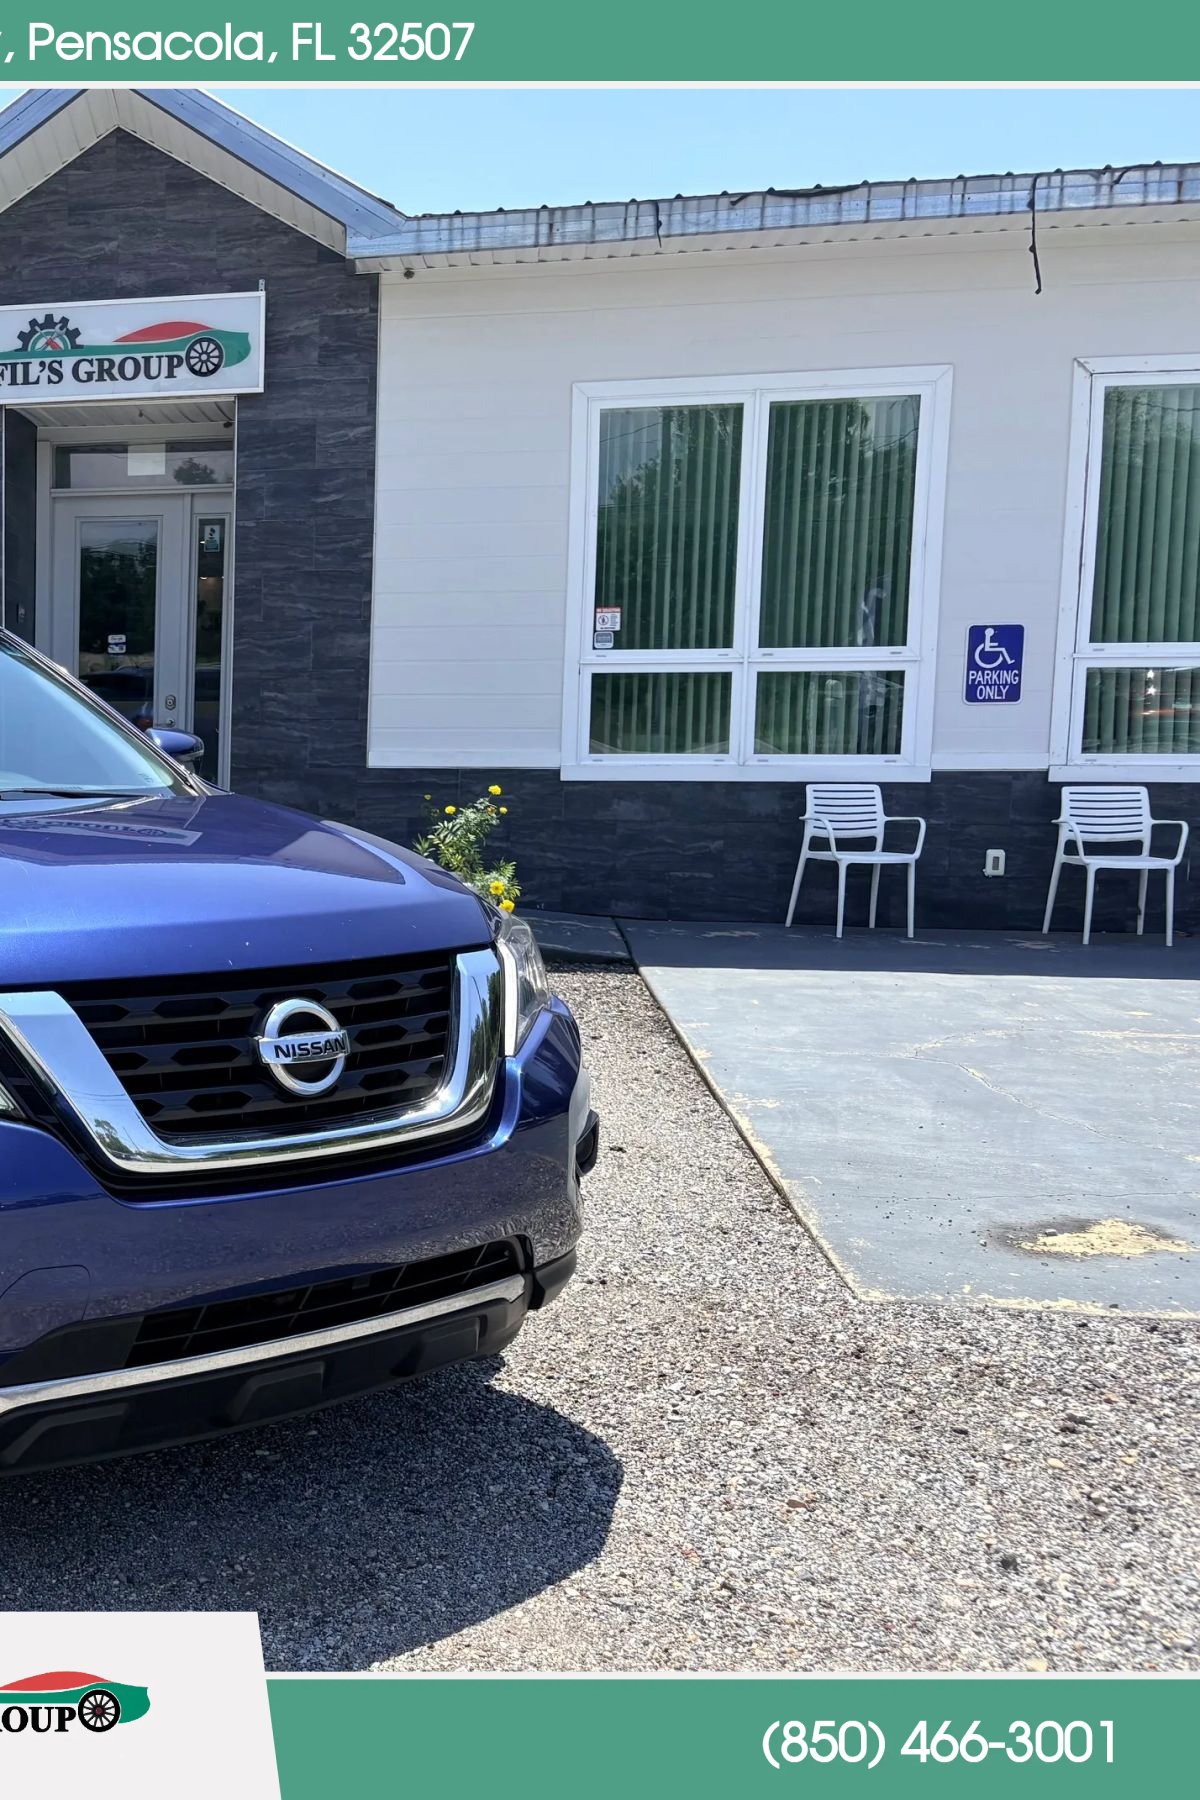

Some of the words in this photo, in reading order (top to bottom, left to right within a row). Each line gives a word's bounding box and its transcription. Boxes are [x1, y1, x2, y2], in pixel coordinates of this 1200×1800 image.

[71, 354, 185, 384] GROUP
[968, 669, 1020, 685] PARKING
[976, 685, 1010, 700] ONLY
[273, 1035, 346, 1059] NISSAN
